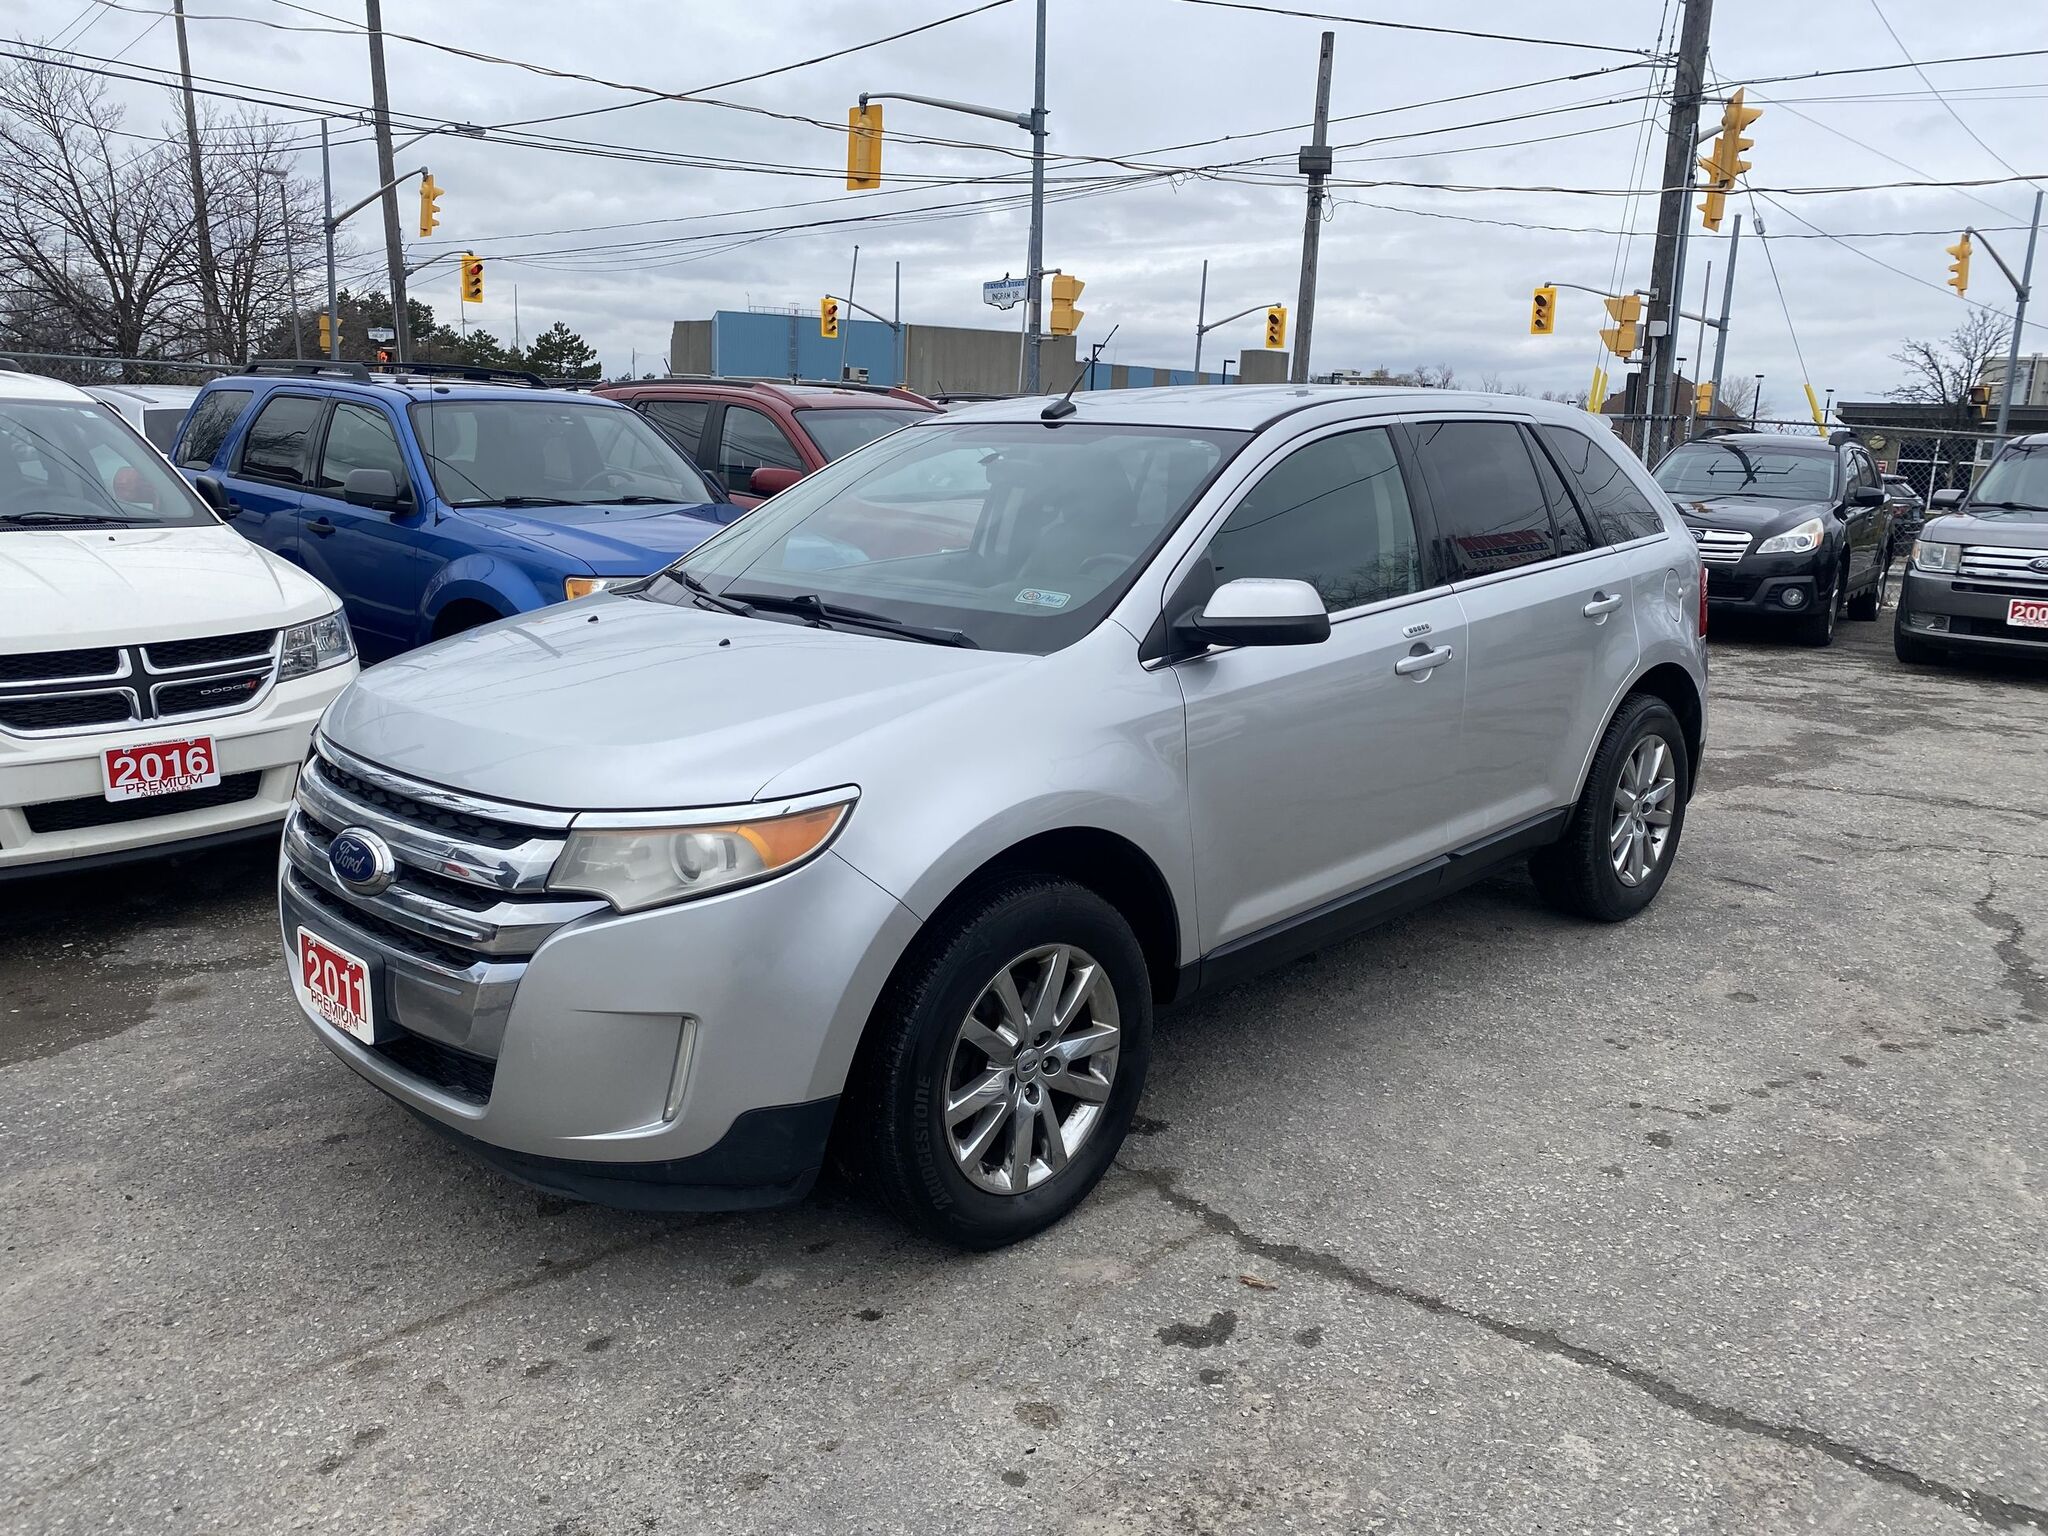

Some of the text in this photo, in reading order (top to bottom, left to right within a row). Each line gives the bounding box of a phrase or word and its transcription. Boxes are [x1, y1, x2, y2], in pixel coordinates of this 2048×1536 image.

[991, 291, 1020, 301] INGRAM DR
[2013, 605, 2048, 621] 200
[200, 682, 250, 695] DODGE
[113, 747, 209, 787] 2016
[125, 775, 203, 794] PREMIUM
[140, 785, 192, 798] AUTO SALES
[335, 841, 366, 874] Ford
[307, 949, 367, 1024] 2011
[311, 989, 359, 1030] PREMIUM
